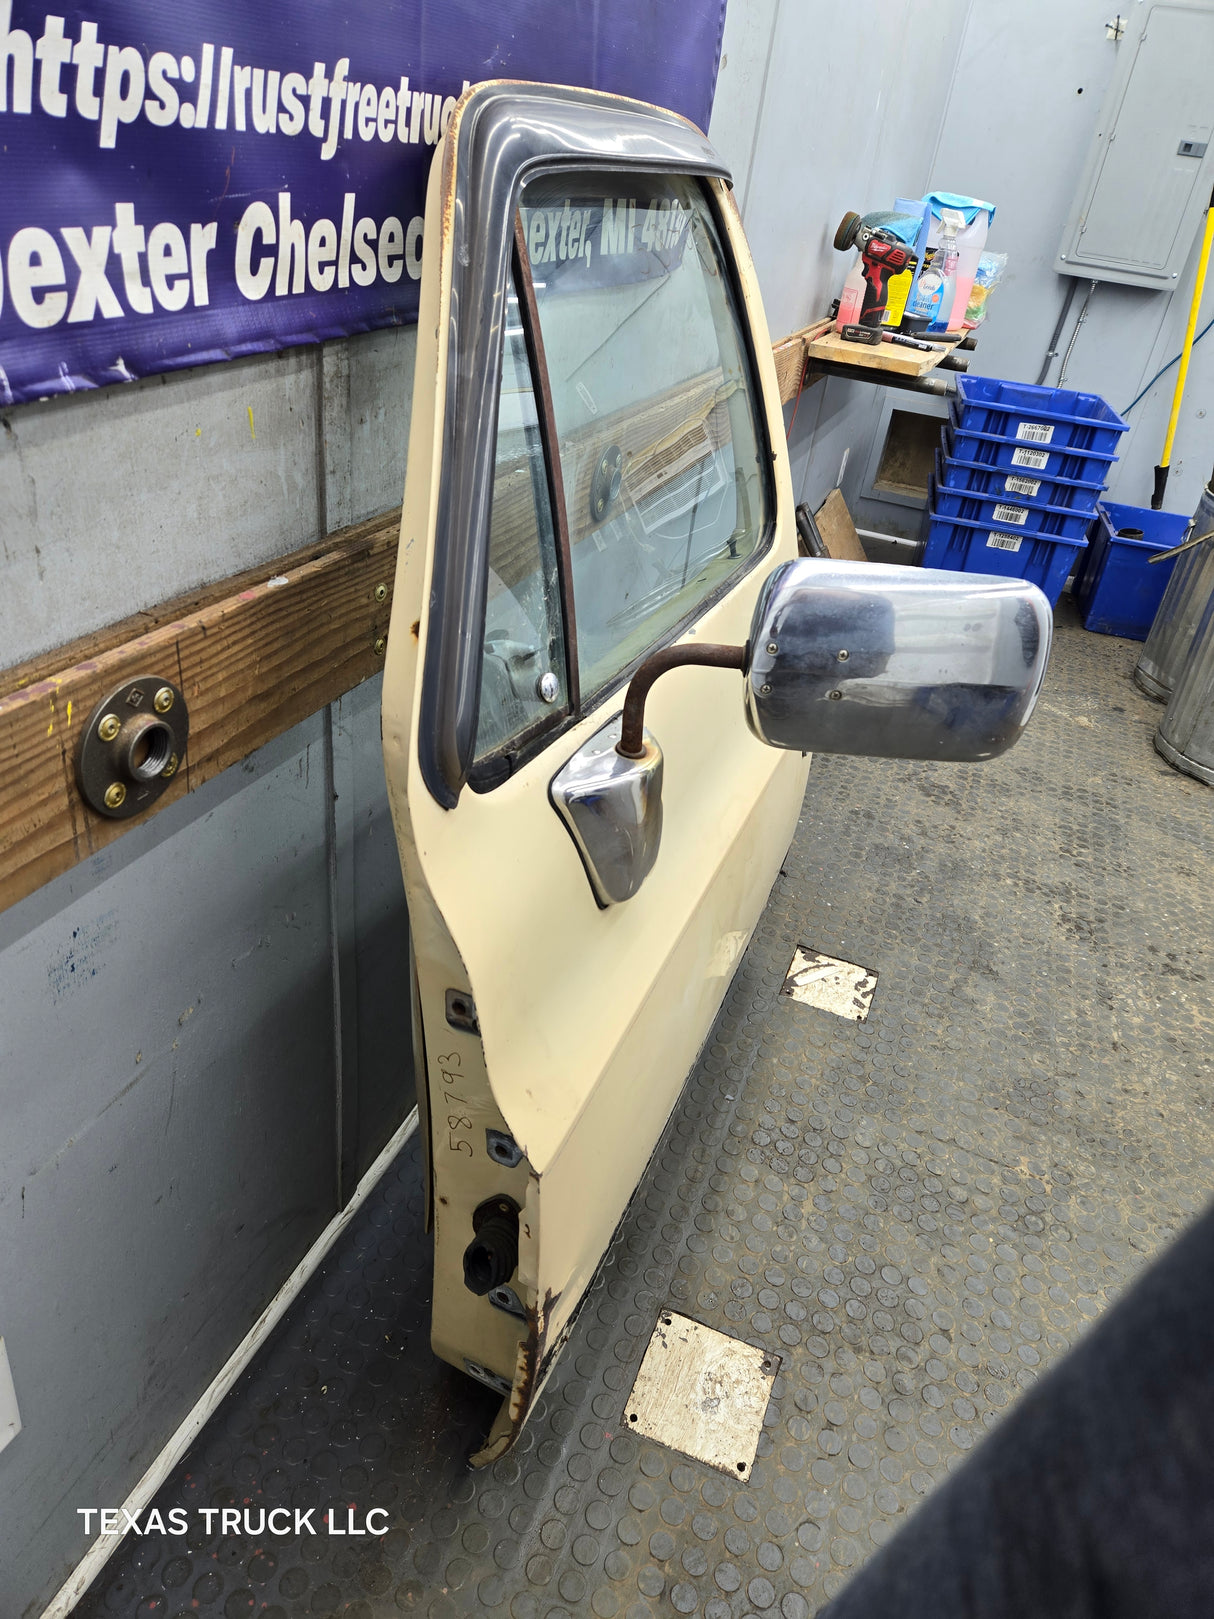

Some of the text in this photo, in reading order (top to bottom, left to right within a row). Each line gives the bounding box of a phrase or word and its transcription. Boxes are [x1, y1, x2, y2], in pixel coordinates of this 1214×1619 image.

[0, 0, 470, 160] https://rustfreetruc
[0, 202, 218, 329] exter
[600, 198, 637, 256] MI
